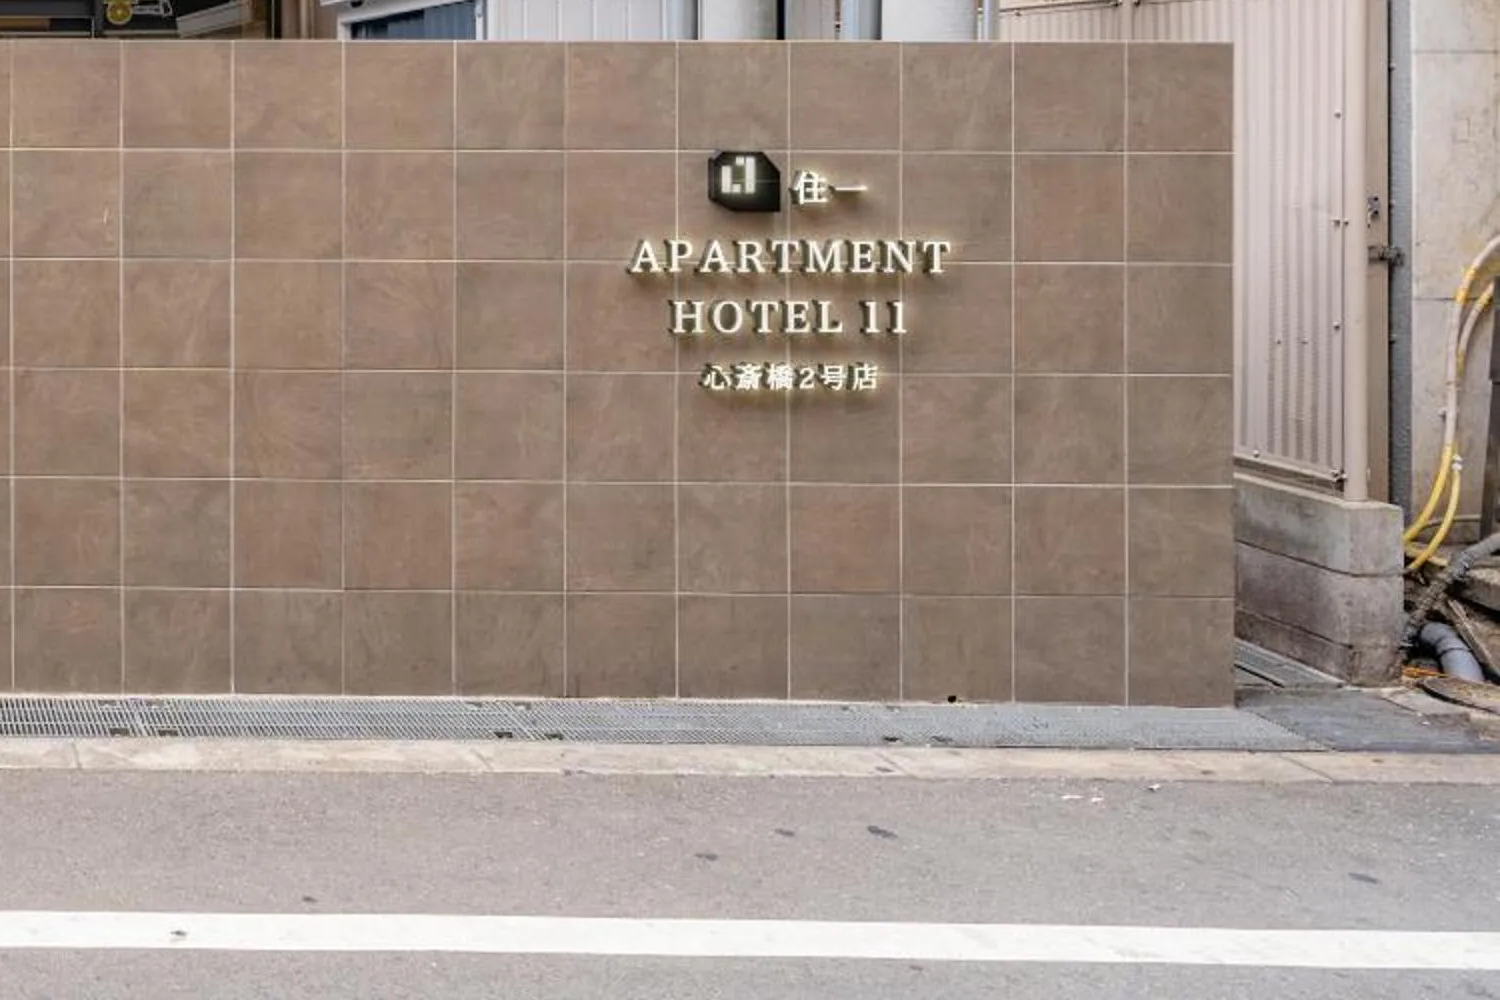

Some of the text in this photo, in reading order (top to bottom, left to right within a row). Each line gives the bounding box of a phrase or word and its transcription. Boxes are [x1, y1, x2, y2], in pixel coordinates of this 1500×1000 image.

[794, 169, 869, 205] 住一
[630, 239, 952, 274] APARTMENT
[672, 300, 908, 334] HOTEL 11
